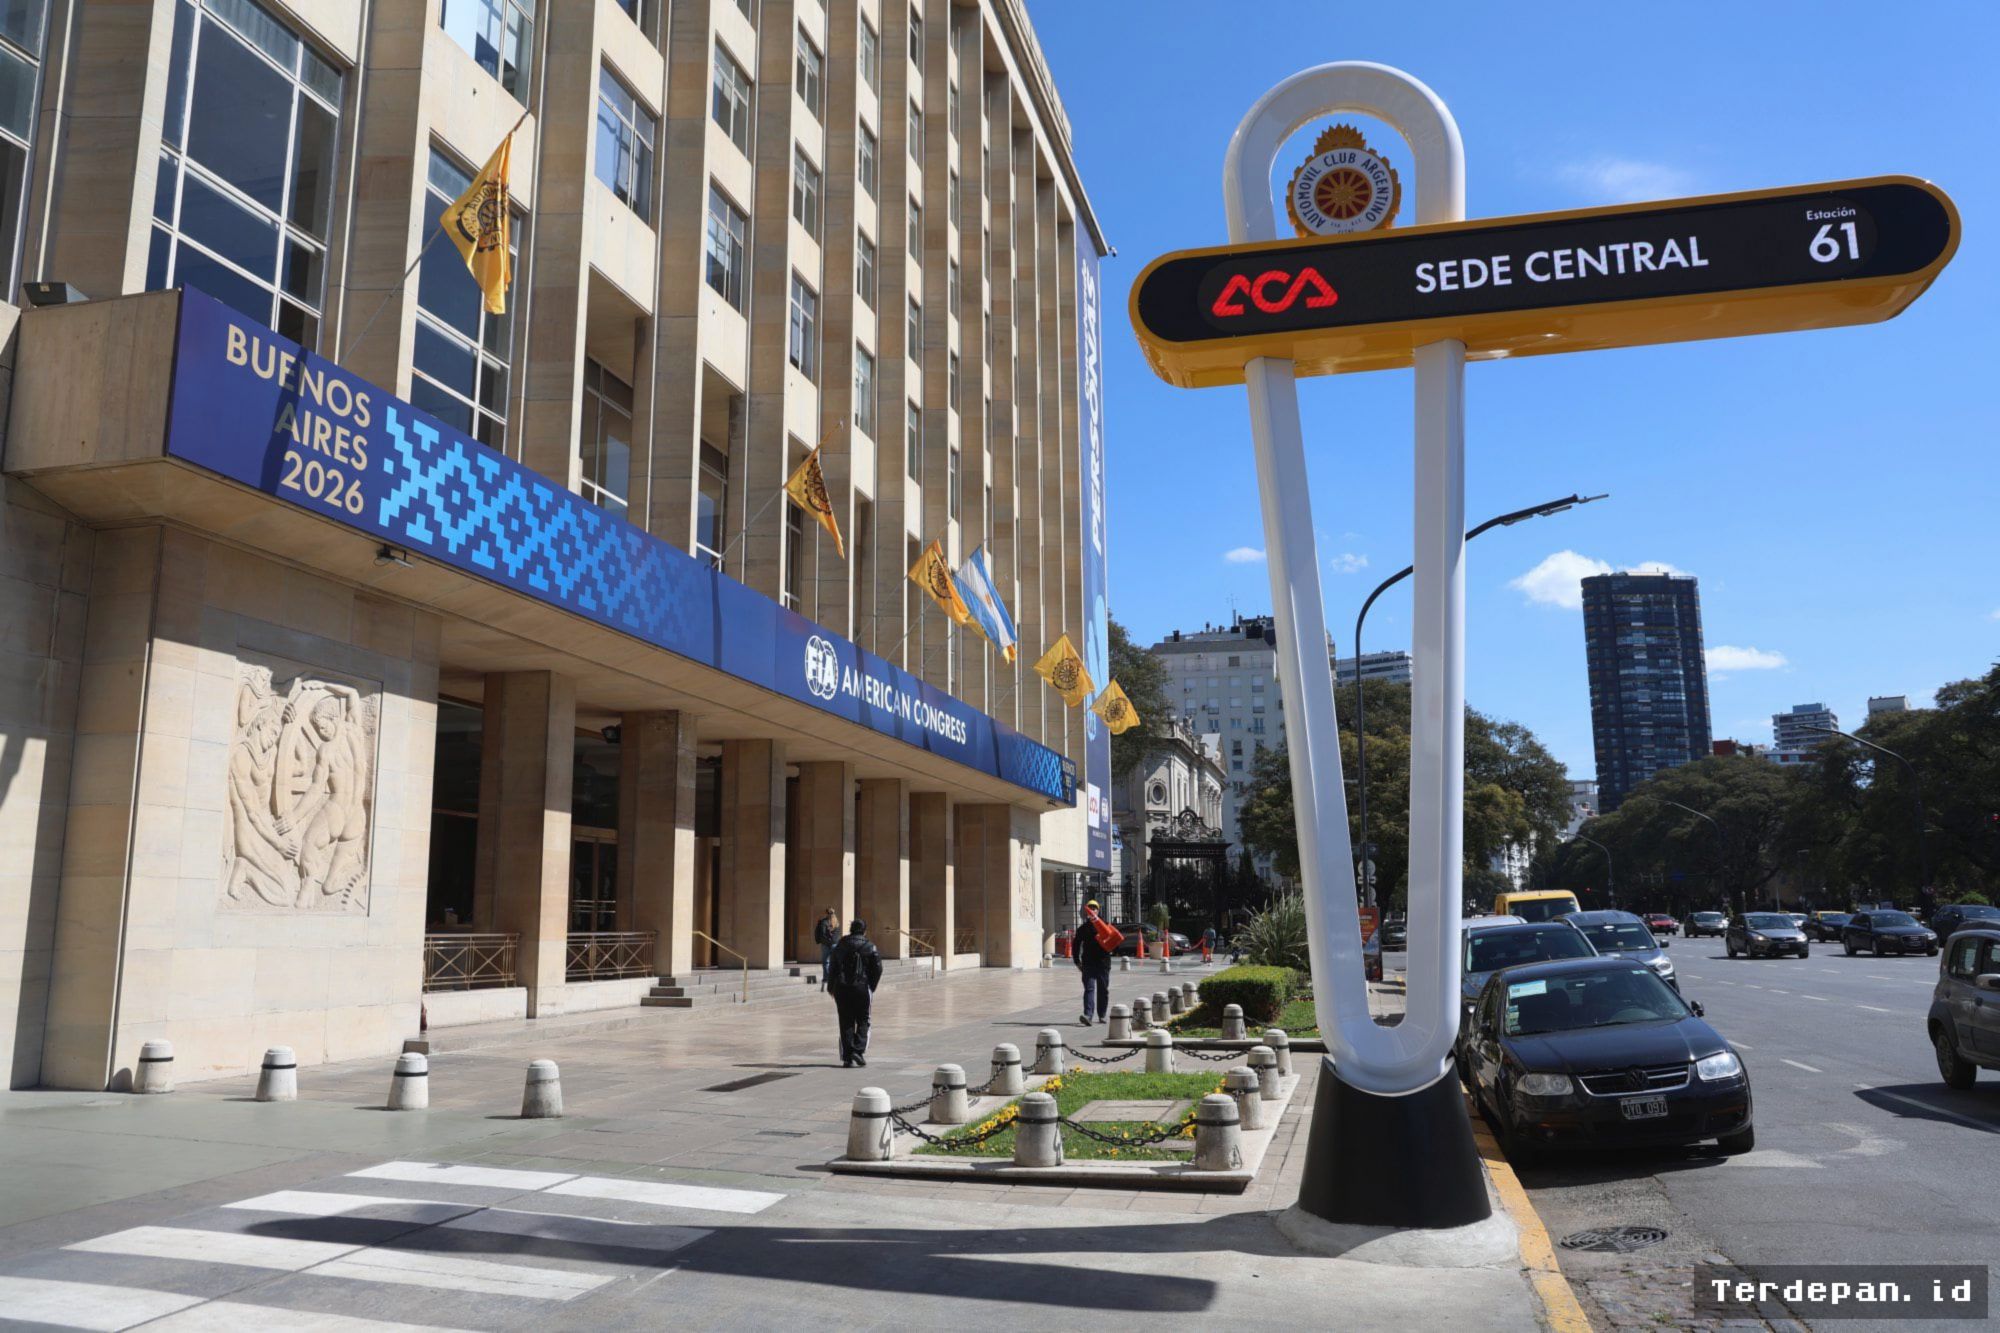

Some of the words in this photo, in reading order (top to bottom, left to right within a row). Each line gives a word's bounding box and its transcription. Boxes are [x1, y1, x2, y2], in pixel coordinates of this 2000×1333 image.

[1298, 166, 1326, 228] AUTOMOVIL
[1323, 152, 1357, 167] CLUB
[1360, 158, 1389, 222] ARGENTINO
[1806, 206, 1857, 221] Estación
[1414, 254, 1513, 294] SEDE
[1525, 236, 1709, 283] CENTRAL
[1809, 221, 1860, 263] 61
[1211, 266, 1339, 318] ACA
[226, 323, 371, 429] BUENOS
[274, 402, 369, 472] AIRES
[1087, 275, 1102, 557] PERSONAS
[281, 450, 365, 515] 2026
[841, 665, 911, 721] AMERICAN
[913, 699, 967, 745] CONGRESS
